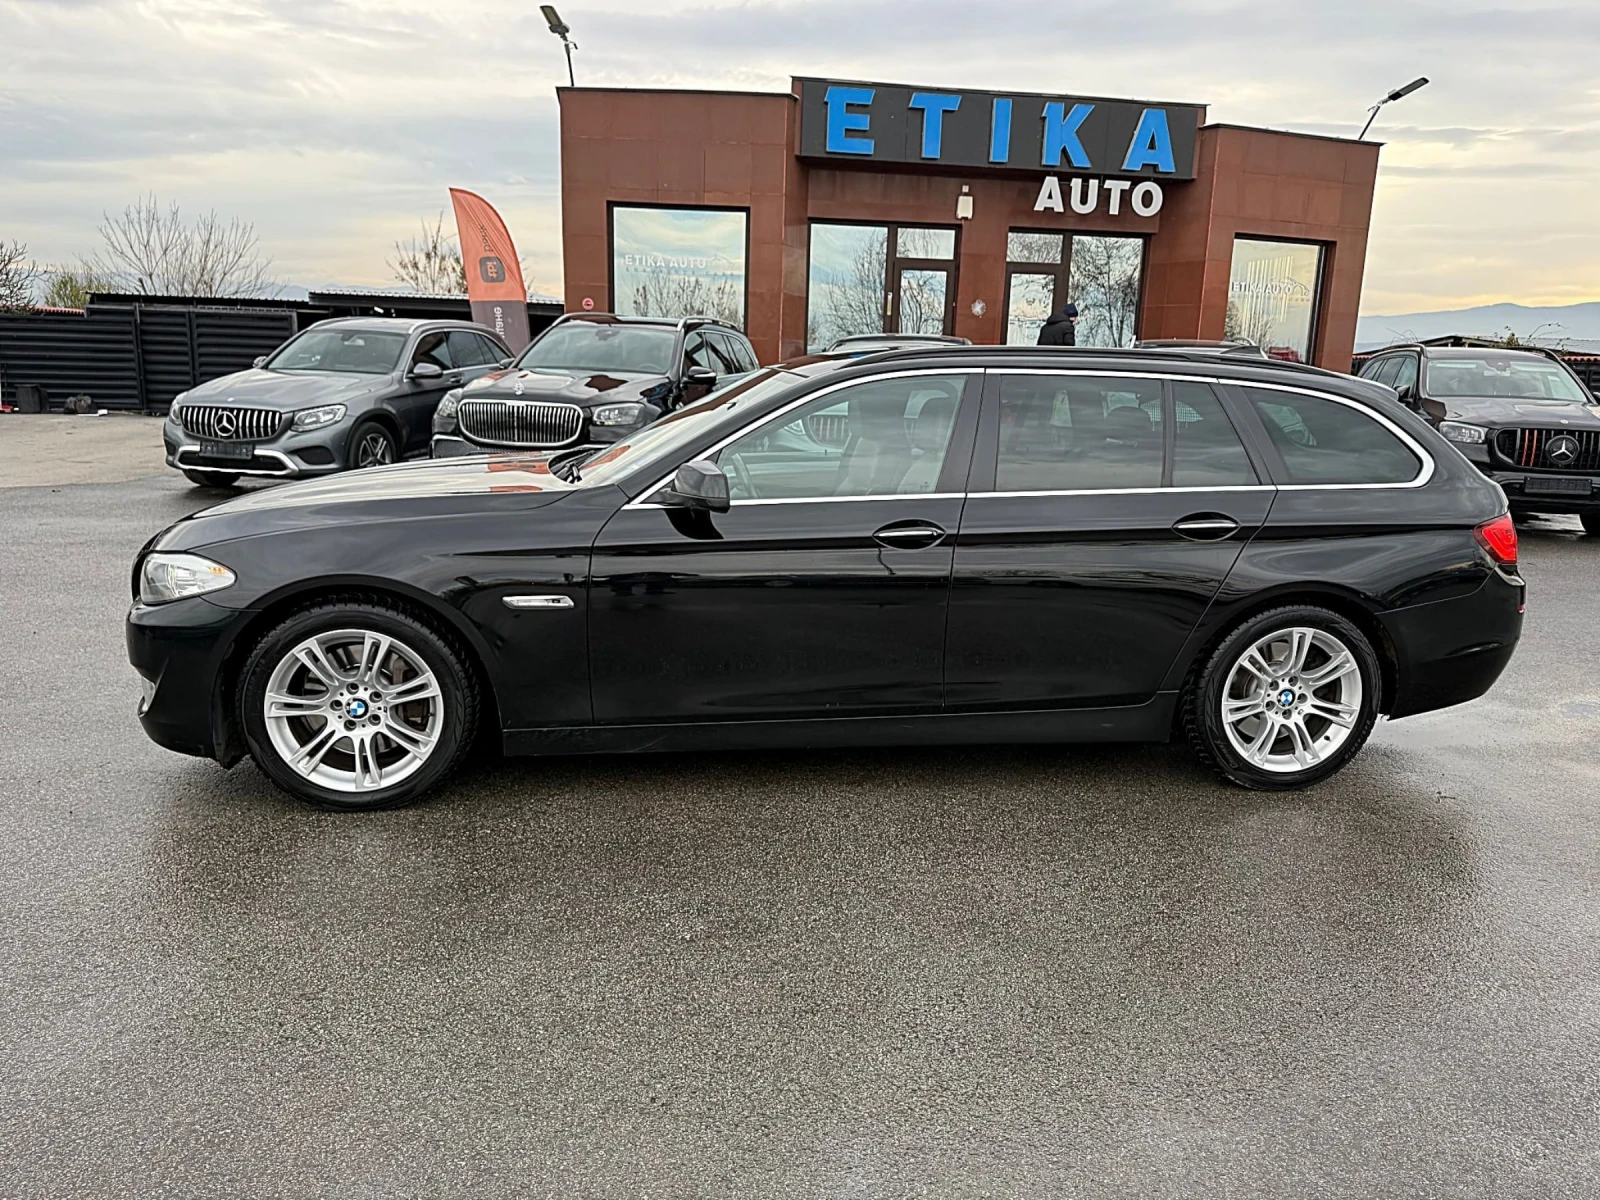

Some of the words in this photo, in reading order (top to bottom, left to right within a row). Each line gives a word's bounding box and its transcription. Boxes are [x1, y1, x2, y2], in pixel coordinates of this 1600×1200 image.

[824, 85, 1176, 173] ETIKA
[1033, 176, 1164, 218] AUTO
[624, 254, 665, 267] ETIKA
[669, 256, 707, 269] AUTO
[1232, 281, 1263, 294] ETIKA
[1264, 283, 1292, 295] AUTO
